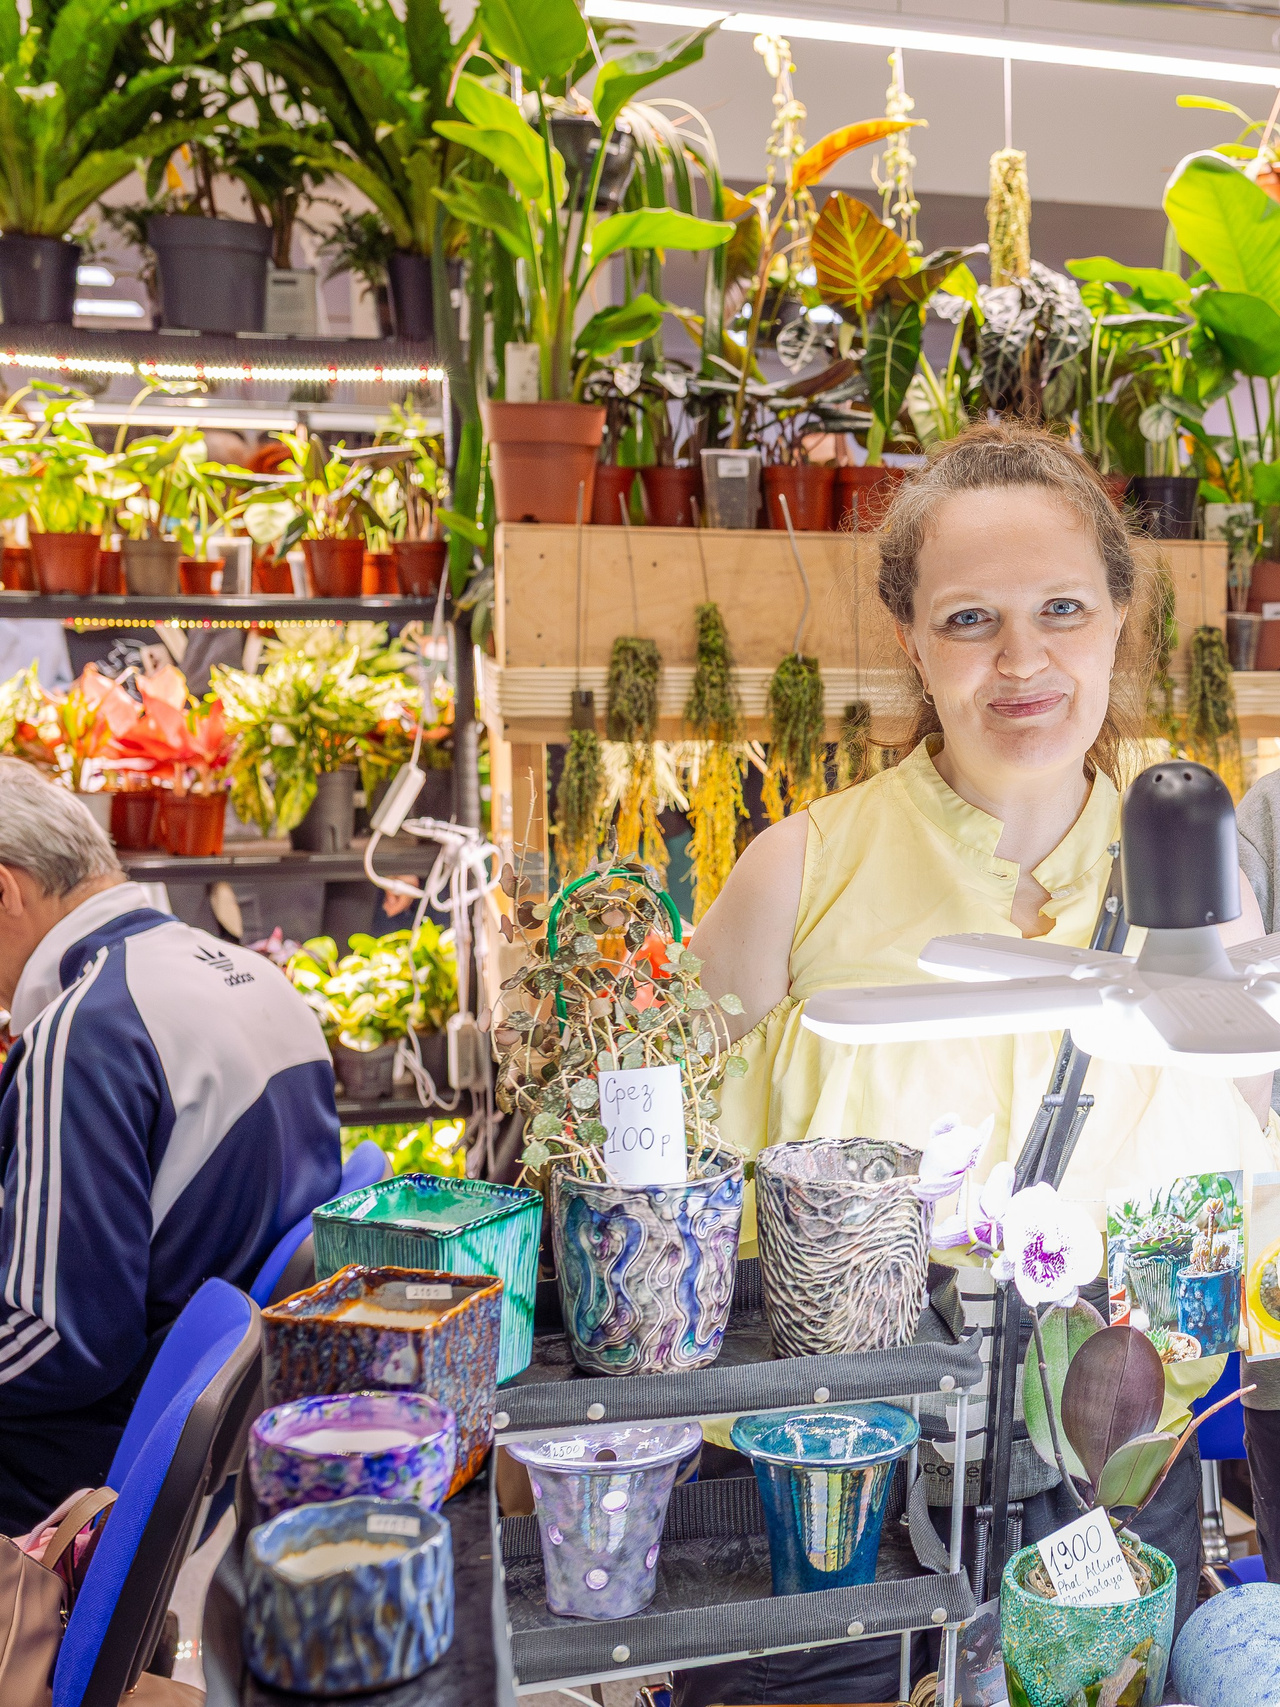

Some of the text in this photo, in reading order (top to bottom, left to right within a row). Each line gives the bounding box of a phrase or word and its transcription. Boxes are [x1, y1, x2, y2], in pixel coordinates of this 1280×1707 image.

[224, 972, 255, 986] adidas
[604, 1077, 655, 1115] Срез
[608, 1126, 655, 1154] 100
[552, 1444, 581, 1459] 2500
[923, 1462, 980, 1478] coe
[1050, 1524, 1102, 1578] 1900
